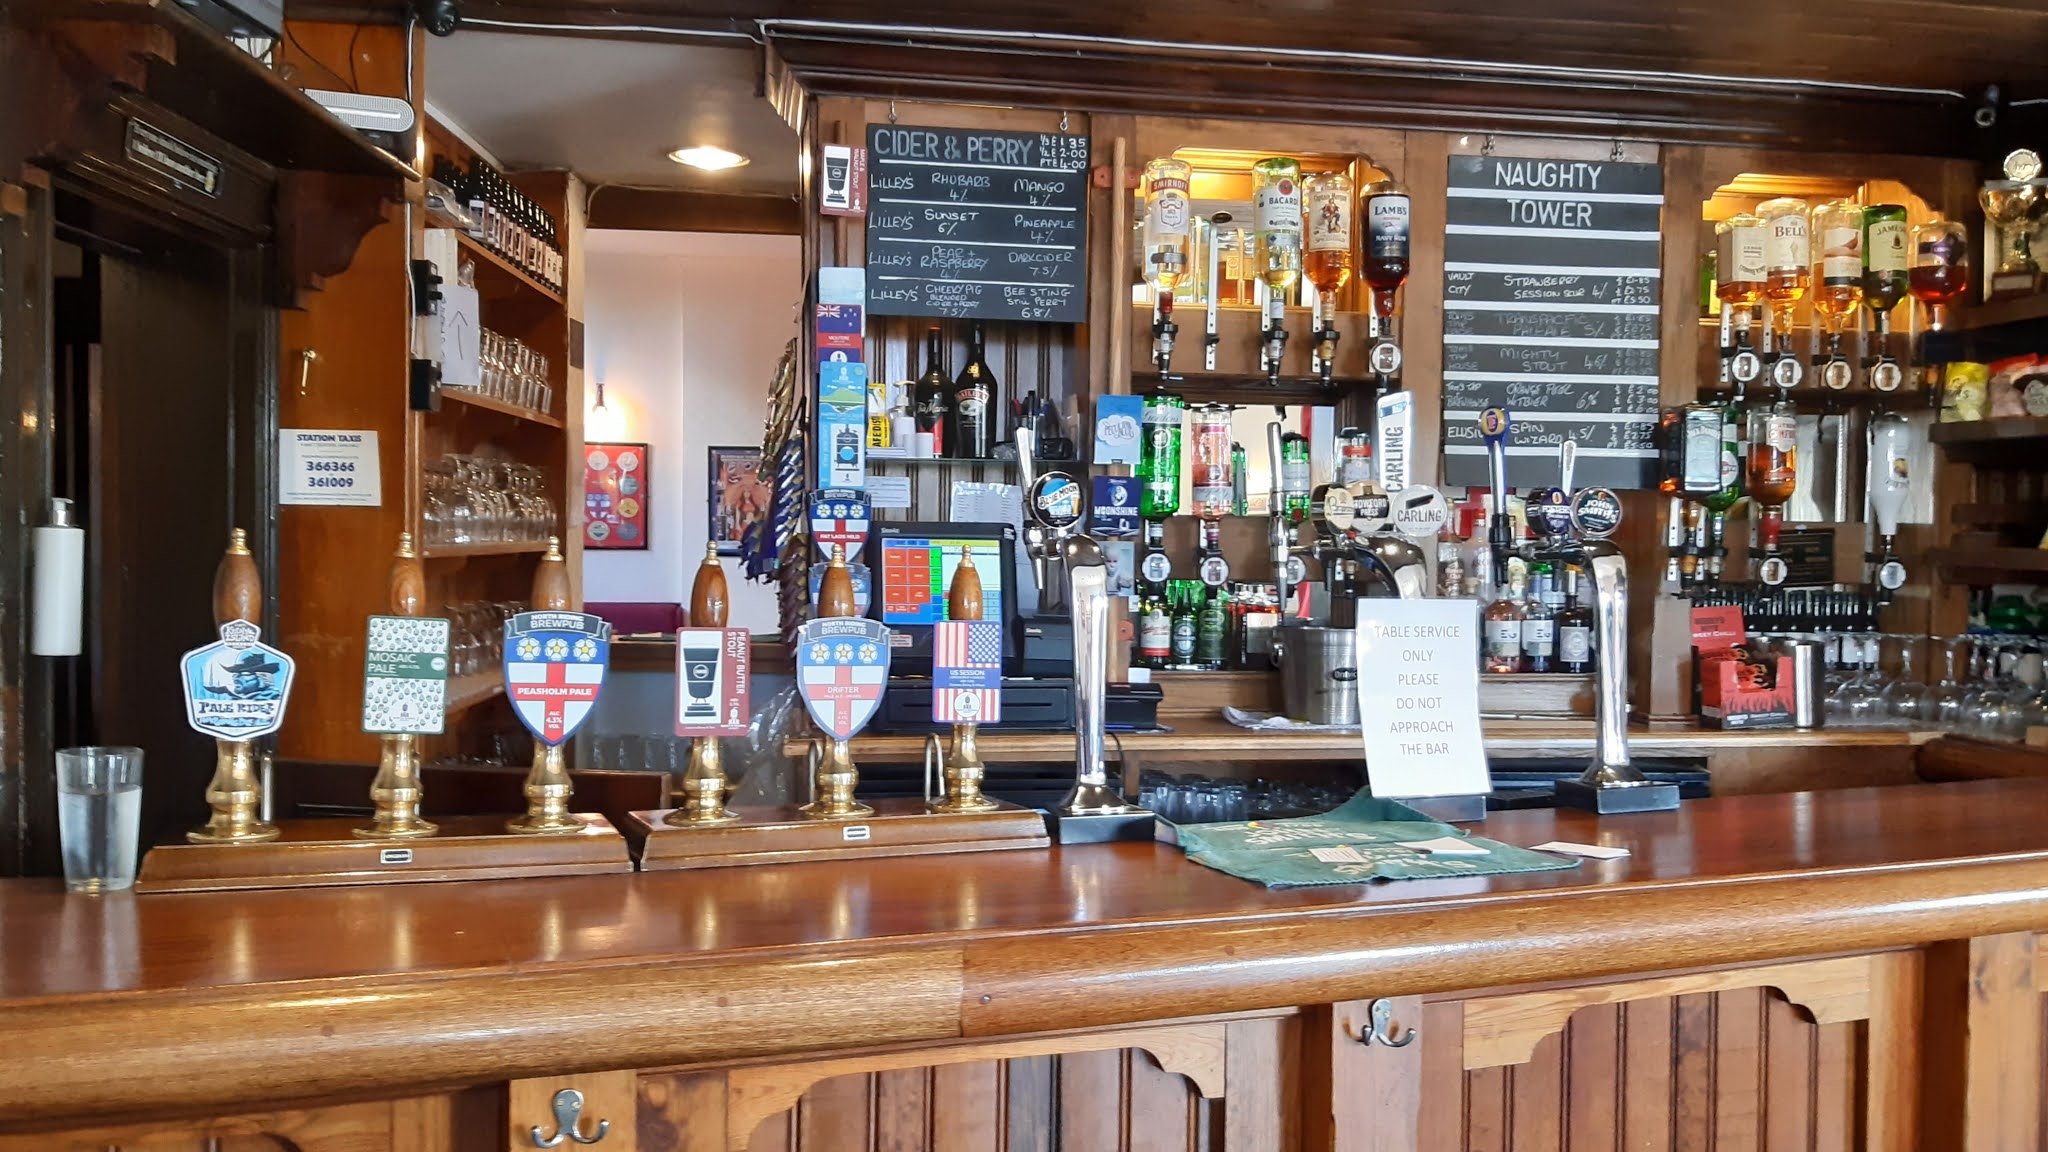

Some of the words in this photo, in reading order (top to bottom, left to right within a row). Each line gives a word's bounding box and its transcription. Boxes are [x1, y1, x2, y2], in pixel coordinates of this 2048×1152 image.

[875, 129, 939, 158] CIDER
[944, 136, 961, 160] &
[967, 136, 1033, 165] PERRY
[931, 172, 990, 188] RHUBARB
[1495, 162, 1602, 190] NAUGHTY
[1014, 179, 1064, 193] MANGO
[924, 208, 979, 221] SUNSET
[1507, 199, 1592, 227] TOWER
[1014, 214, 1075, 229] PINEAPPLE
[931, 245, 965, 259] PEAR
[920, 255, 989, 271] RASPBERRY
[1504, 275, 1580, 287] STRAWBERRY
[1003, 286, 1027, 297] BEE
[1029, 287, 1071, 297] STING
[1448, 285, 1472, 296] CITY
[1513, 289, 1560, 299] SESSION
[1034, 297, 1066, 306] PERRY
[1500, 348, 1560, 360] MIGHTY
[1522, 361, 1568, 372] STOUT
[1509, 422, 1544, 434] SPIN
[297, 434, 335, 442] STATION
[1514, 433, 1563, 445] WIZARD
[1385, 426, 1404, 493] CARLING
[306, 461, 355, 471] 366366
[308, 477, 354, 487] 361009
[1094, 506, 1138, 516] MOONSHINE
[1584, 499, 1614, 511] JOHN
[1397, 509, 1442, 522] CARLING
[530, 620, 584, 630] BREWPUB
[821, 626, 867, 635] BREWPUB
[1375, 626, 1410, 638] TABLE
[1414, 626, 1459, 638] SERVICE
[727, 632, 736, 657] STOUT
[736, 632, 746, 662] PEANUT
[368, 652, 417, 663] MOSAIC
[1402, 650, 1433, 661] ONLY
[367, 663, 397, 673] PALE
[736, 664, 746, 694] BUTTER
[1398, 674, 1439, 685] PLEASE
[199, 702, 234, 714] PALE
[237, 702, 274, 715] RIDER
[1397, 698, 1414, 709] DO
[1418, 697, 1442, 708] NOT
[1390, 721, 1453, 733] APPROACH
[1400, 744, 1422, 755] THE
[1427, 743, 1449, 754] BAR
